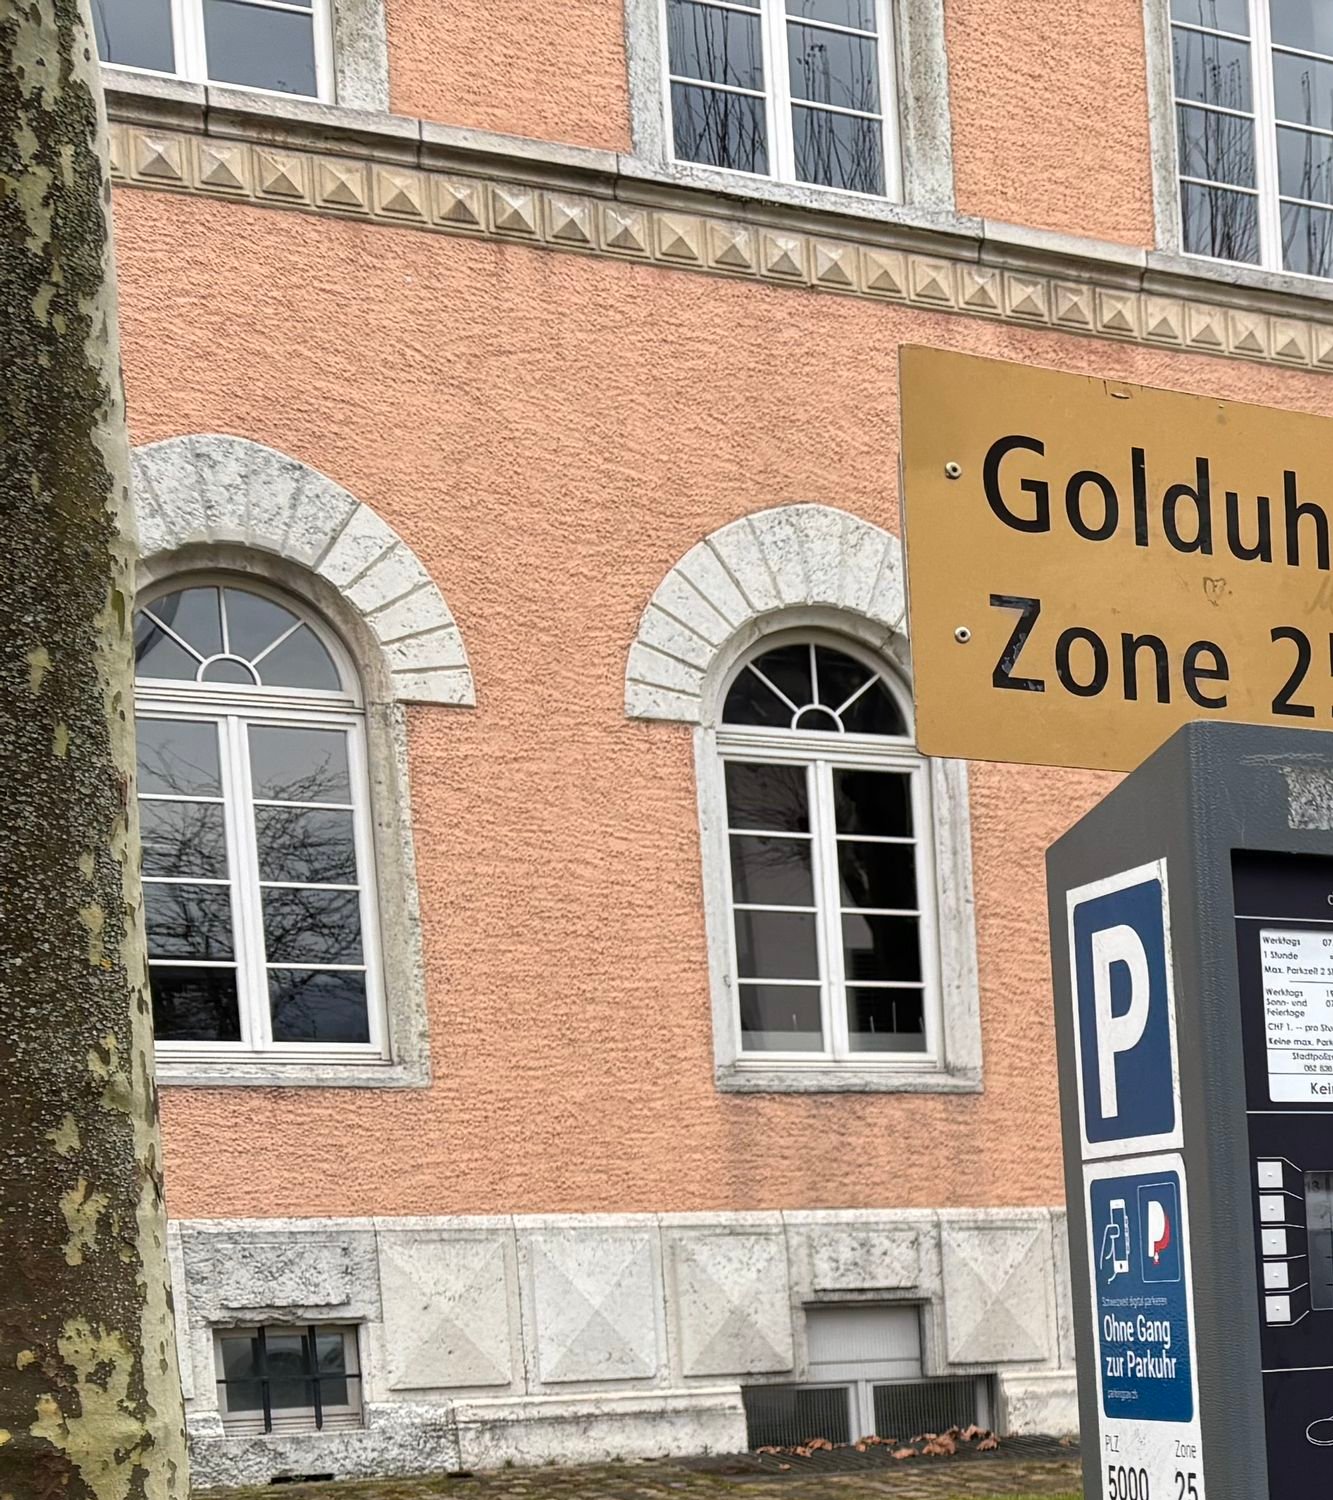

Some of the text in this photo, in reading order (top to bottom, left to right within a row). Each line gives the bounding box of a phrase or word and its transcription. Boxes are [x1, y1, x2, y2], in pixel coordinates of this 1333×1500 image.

[989, 593, 1230, 709] Zone
[1262, 937, 1301, 947] Werktags
[1270, 951, 1298, 960] Stunde
[1287, 967, 1318, 976] Parkzeit
[1320, 967, 1325, 975] 2
[1266, 989, 1303, 997] Werktags
[1292, 999, 1307, 1007] und
[1267, 1008, 1305, 1018] Feiertage
[1091, 924, 1150, 1119] P
[1267, 1023, 1284, 1031] CHF
[1305, 1025, 1318, 1033] pro
[1268, 1038, 1291, 1046] Keine
[1103, 1313, 1171, 1349] Ohne Gang
[1106, 1349, 1177, 1379] zur Parkuhr
[1105, 1434, 1197, 1459] PLZ Zone
